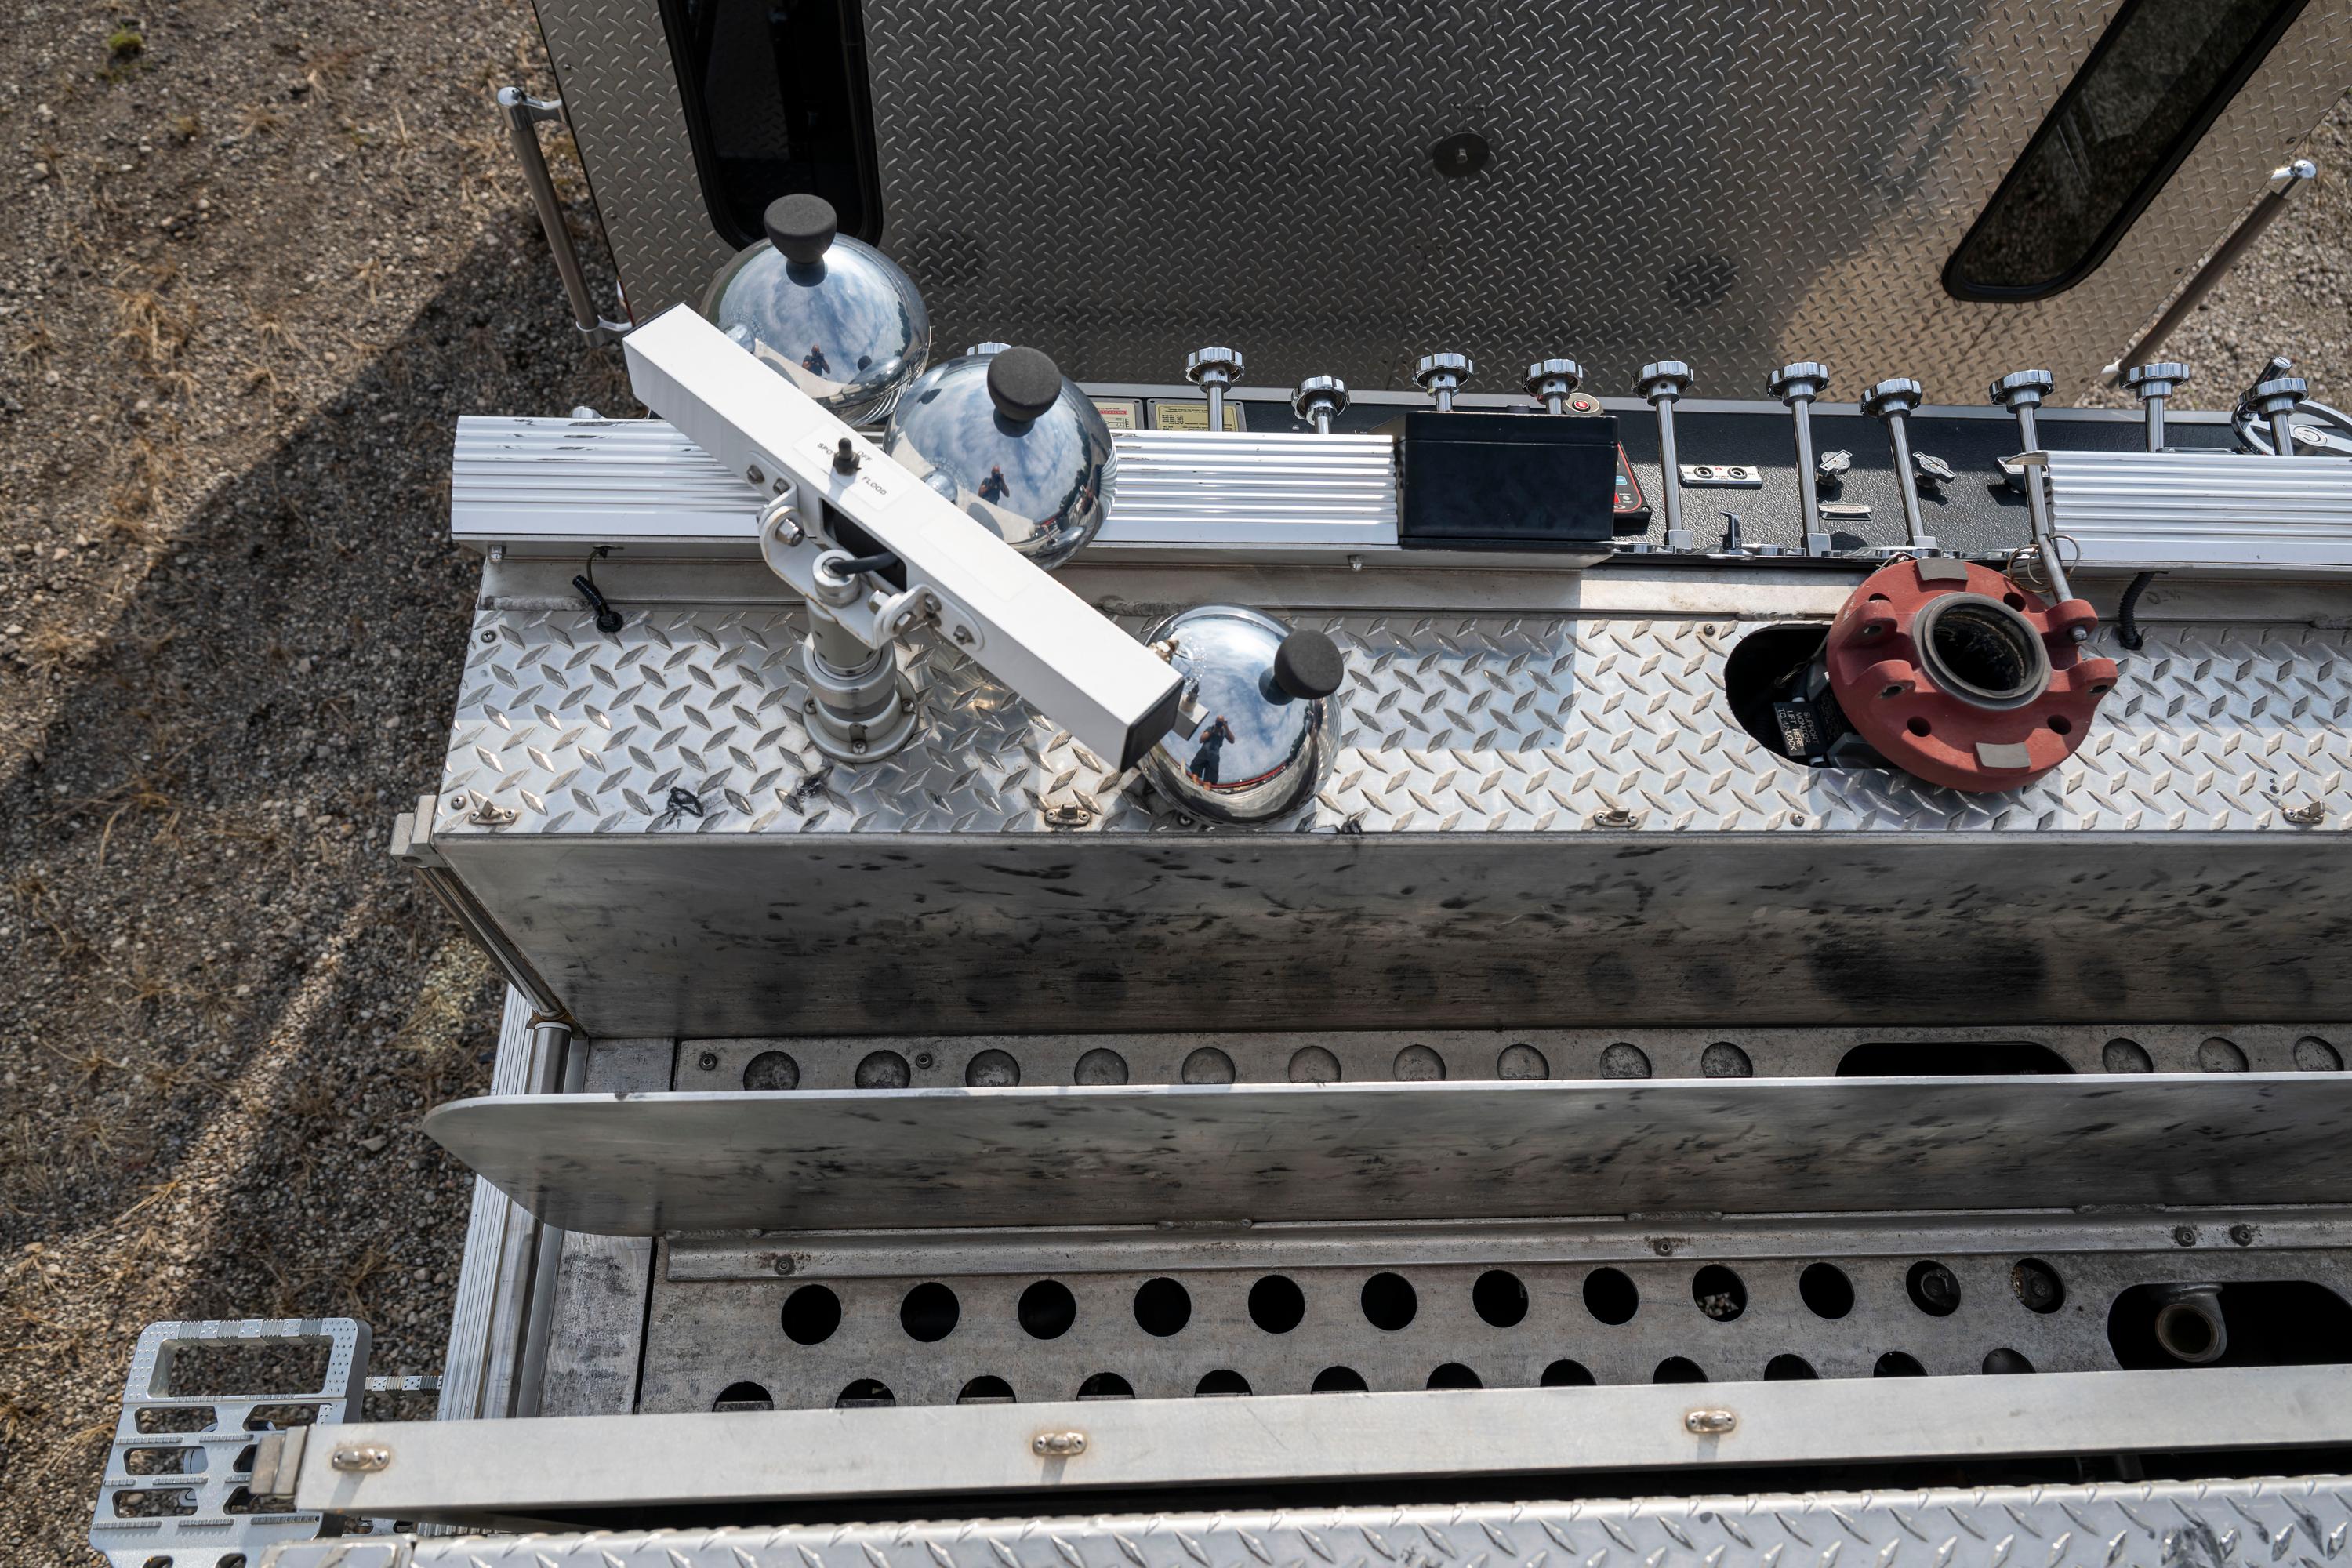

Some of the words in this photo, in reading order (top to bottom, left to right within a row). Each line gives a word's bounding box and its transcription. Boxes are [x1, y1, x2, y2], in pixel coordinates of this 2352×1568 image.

[817, 442, 833, 455] SPO
[858, 450, 872, 462] OFF
[862, 476, 887, 495] FLOOD
[1778, 707, 1787, 718] TO
[1783, 722, 1798, 750] UNLOCK
[1787, 710, 1797, 724] LIFT
[1793, 728, 1804, 747] HERE
[1803, 712, 1819, 743] SUPPORT
